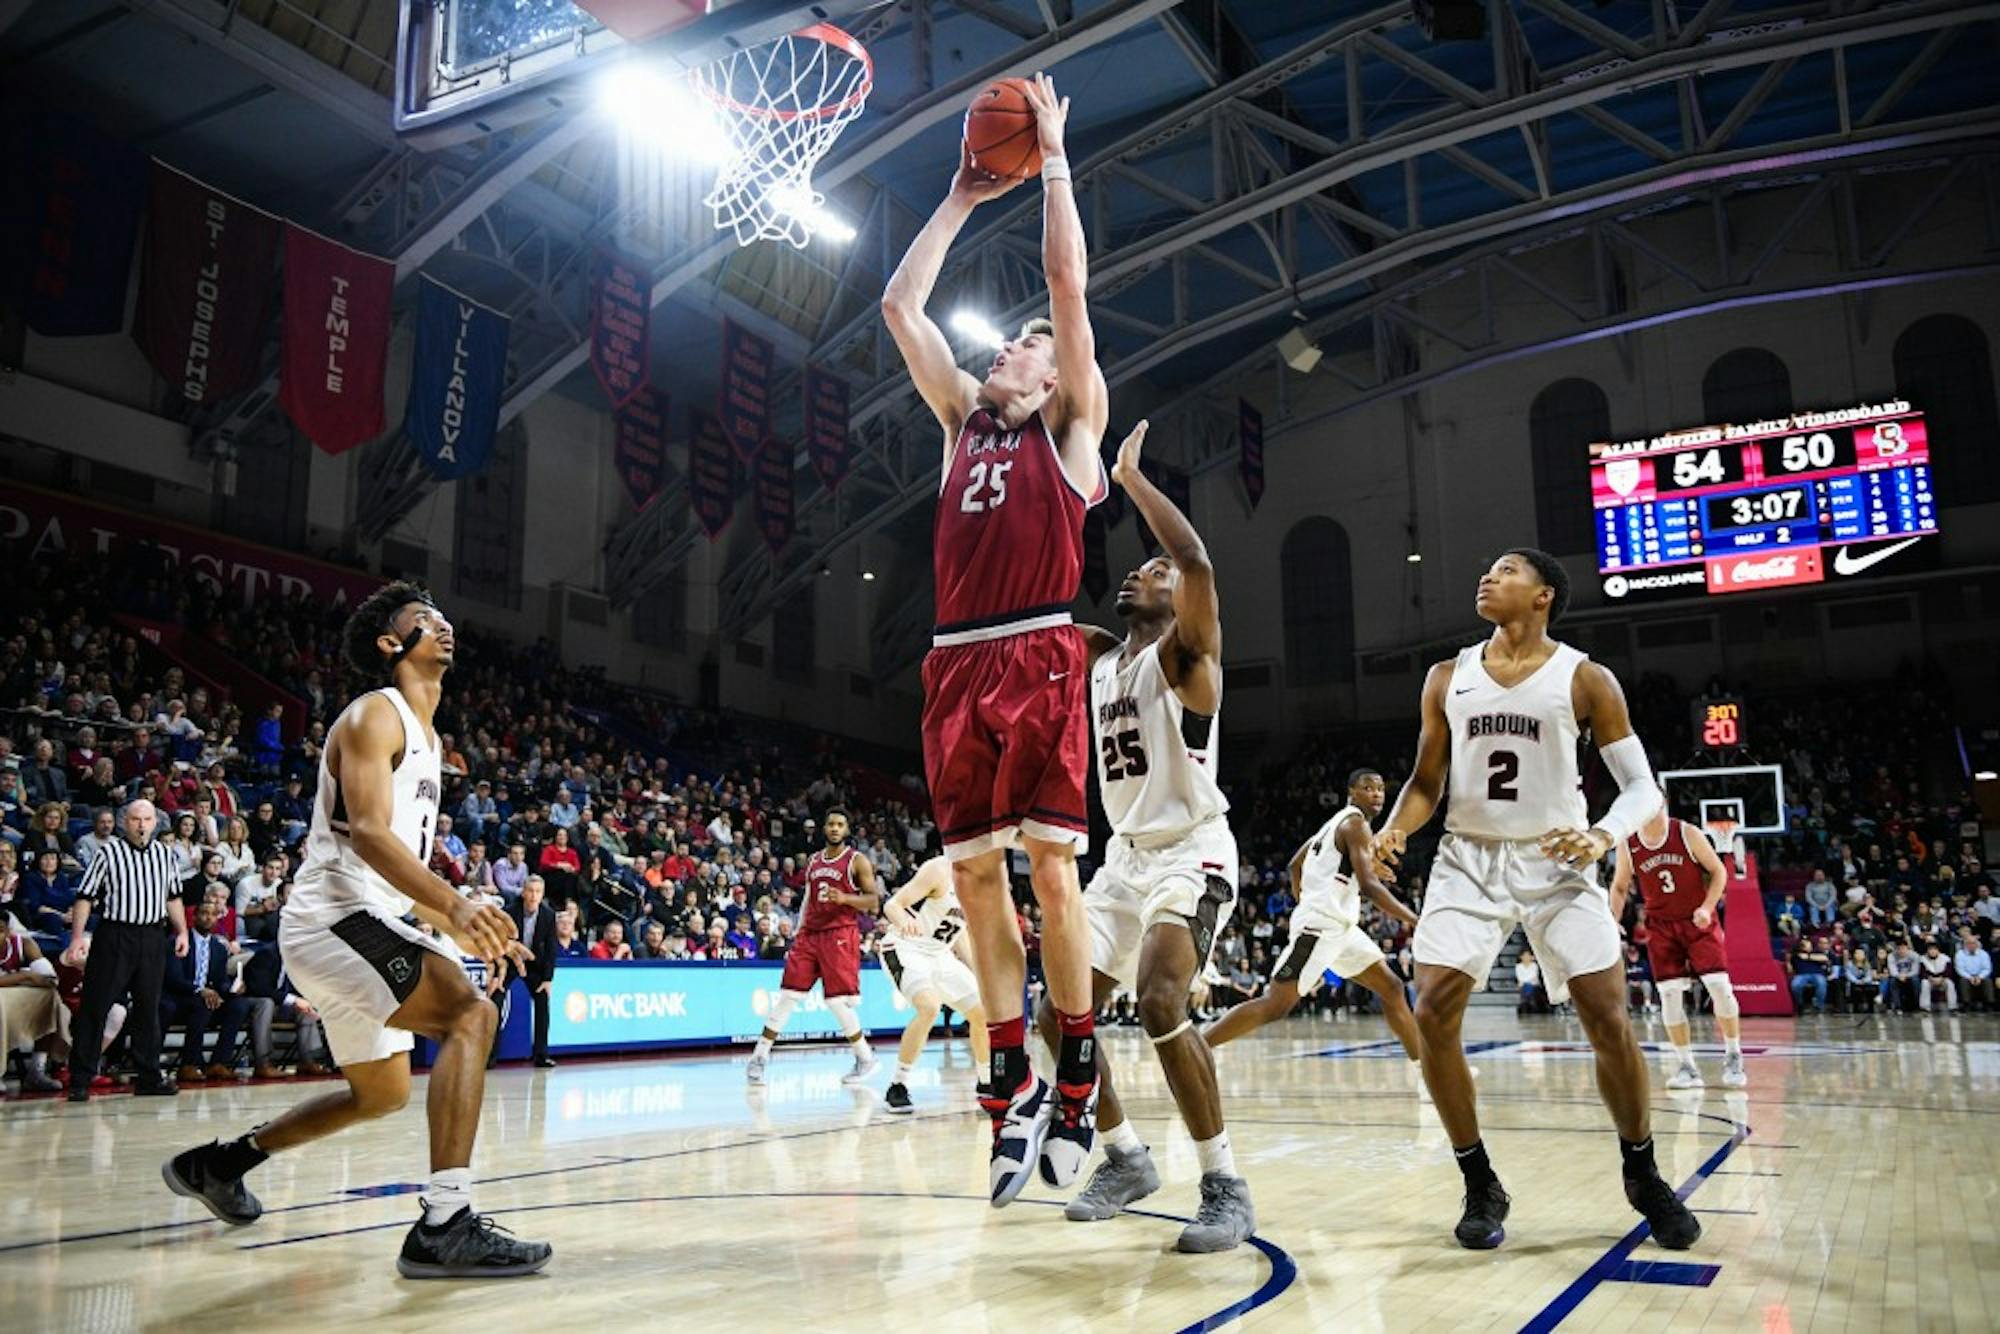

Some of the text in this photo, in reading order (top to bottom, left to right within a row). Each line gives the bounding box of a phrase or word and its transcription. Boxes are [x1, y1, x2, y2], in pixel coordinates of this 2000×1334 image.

[206, 201, 225, 248] ST.
[326, 276, 349, 394] TEMPLE
[437, 303, 474, 464] VILLANOVA
[1725, 418, 1789, 439] FAMILY
[1793, 401, 1911, 429] VIDEOBOARD
[1673, 448, 1725, 487] 54
[1782, 433, 1836, 471] 50
[960, 460, 1013, 512] 25
[1915, 467, 1926, 477] 2
[1731, 490, 1802, 525] 3:07
[1777, 527, 1791, 543] 2
[0, 504, 348, 612] ASTR
[1467, 711, 1541, 743] BROWN
[1703, 720, 1736, 745] 20
[1102, 728, 1148, 782] 25
[1488, 749, 1519, 802] 2
[1657, 869, 1676, 894] 3
[932, 919, 962, 945] 21
[589, 991, 688, 1019] PNC BANK
